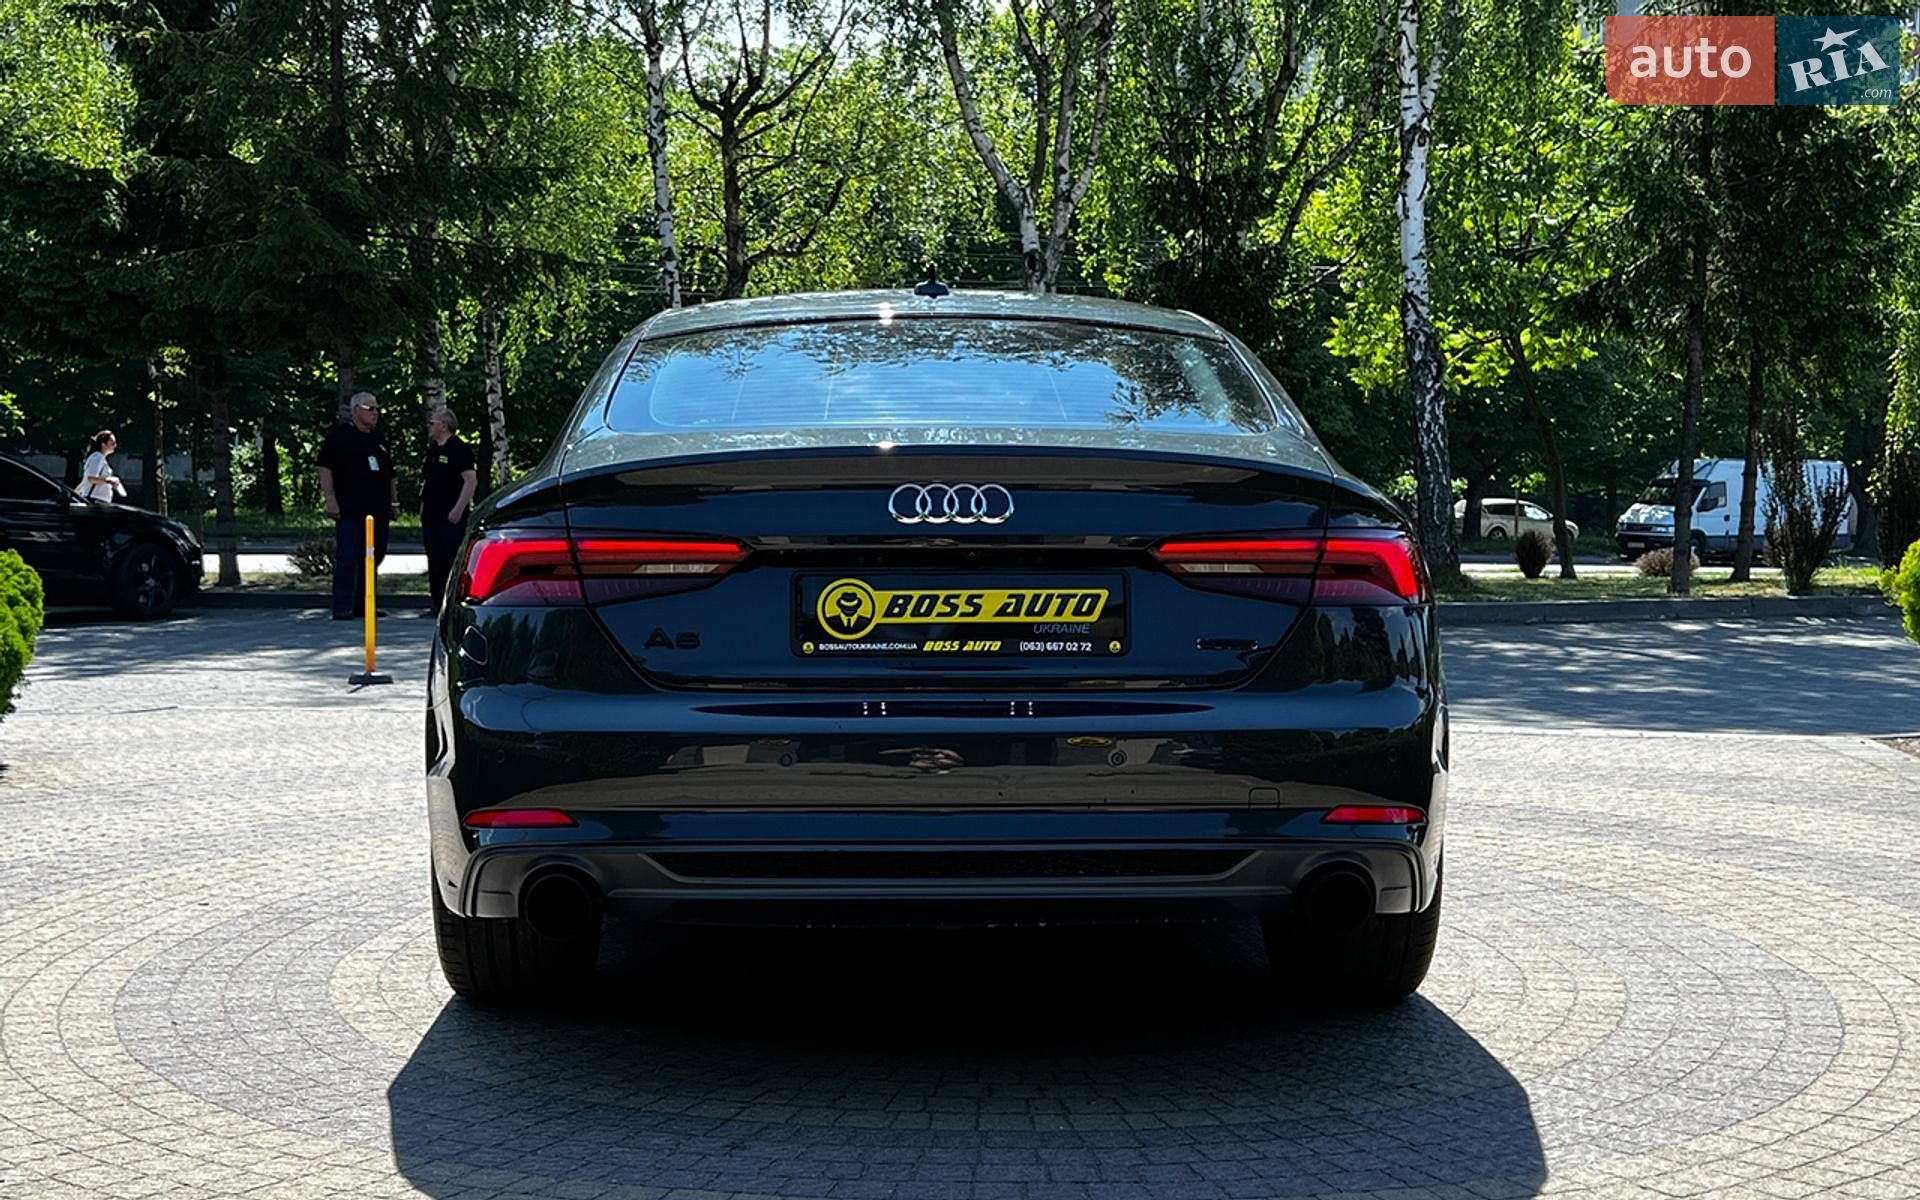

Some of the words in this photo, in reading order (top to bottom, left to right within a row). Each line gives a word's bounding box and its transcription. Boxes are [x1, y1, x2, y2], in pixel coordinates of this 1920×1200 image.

[882, 592, 985, 618] BOSS
[993, 592, 1103, 618] AUTO
[1033, 623, 1091, 635] UKRAINE
[922, 641, 960, 652] BOSS
[963, 641, 1002, 652] AUTO
[1065, 642, 1079, 652] 02
[1079, 642, 1093, 652] 72
